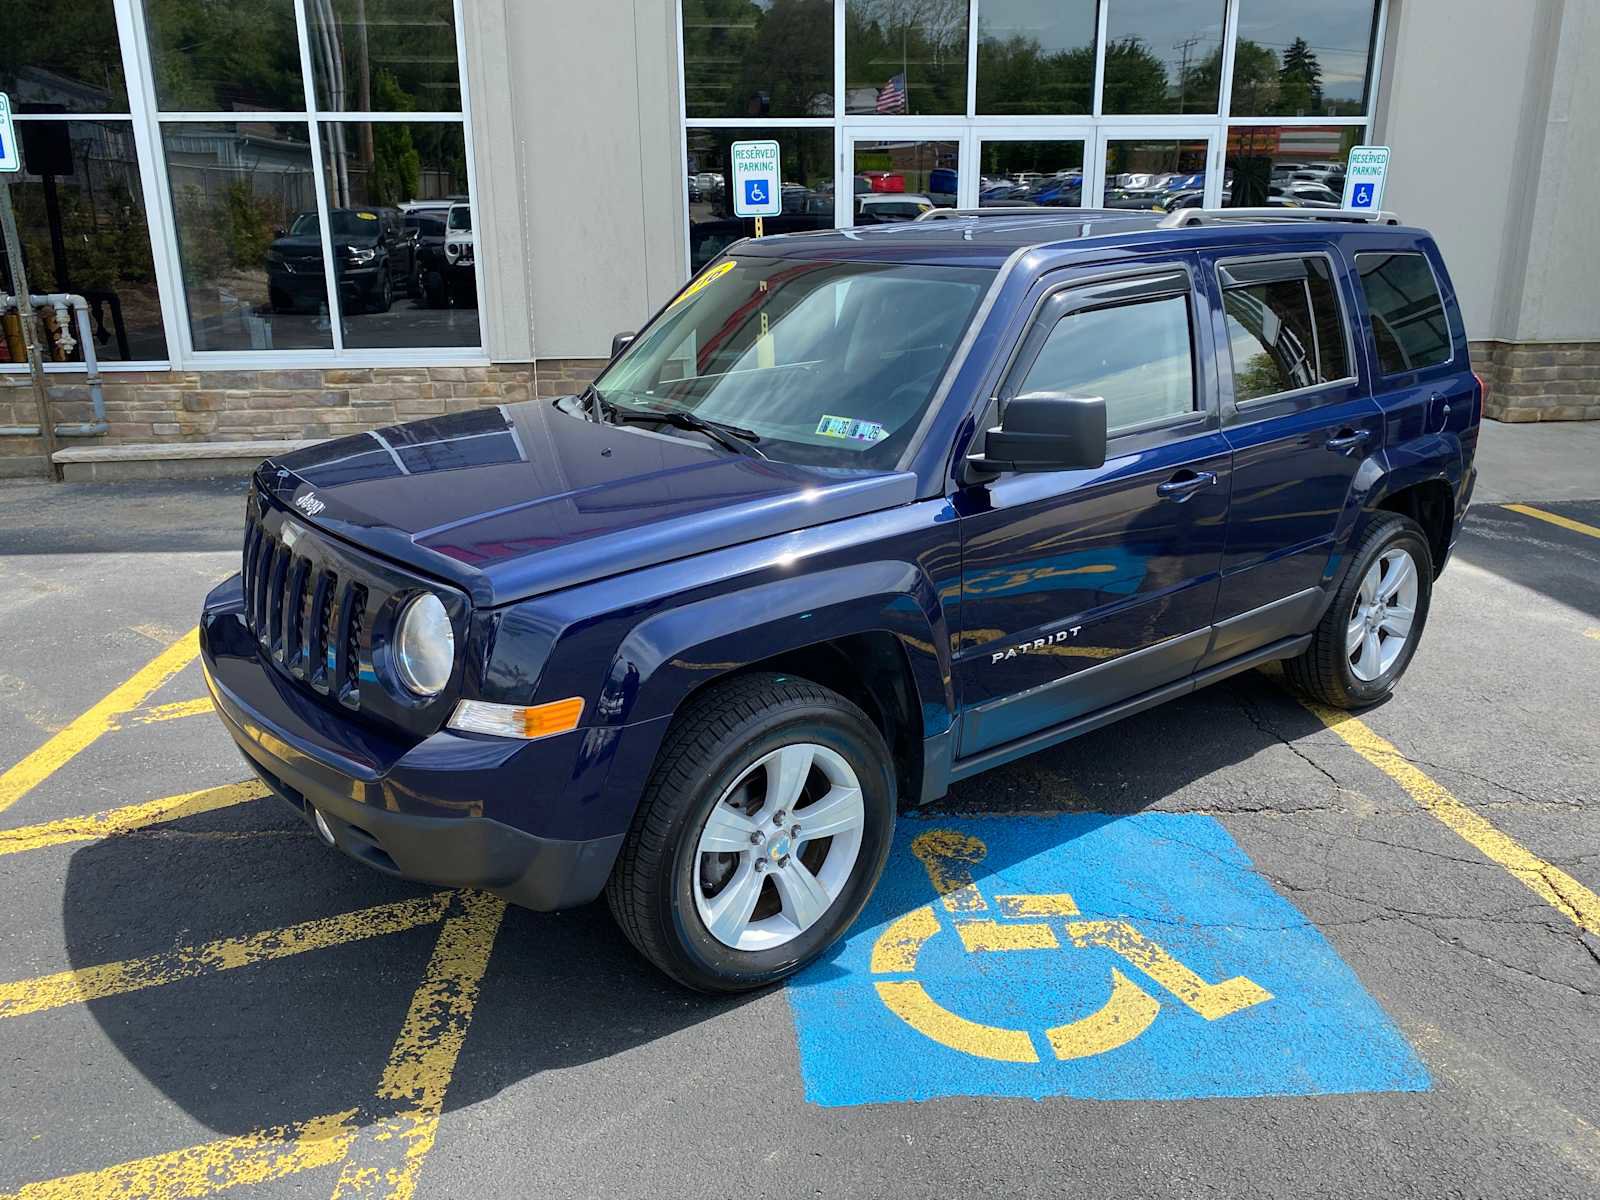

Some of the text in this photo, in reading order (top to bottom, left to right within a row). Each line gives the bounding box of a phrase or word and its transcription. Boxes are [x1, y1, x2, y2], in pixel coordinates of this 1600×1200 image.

[735, 149, 776, 159] RESERVED
[1352, 154, 1386, 164] RESERVED
[739, 161, 774, 171] PARKING
[1353, 166, 1382, 175] PARKING
[296, 492, 326, 516] Jeep
[991, 625, 1082, 665] PATRIOT
